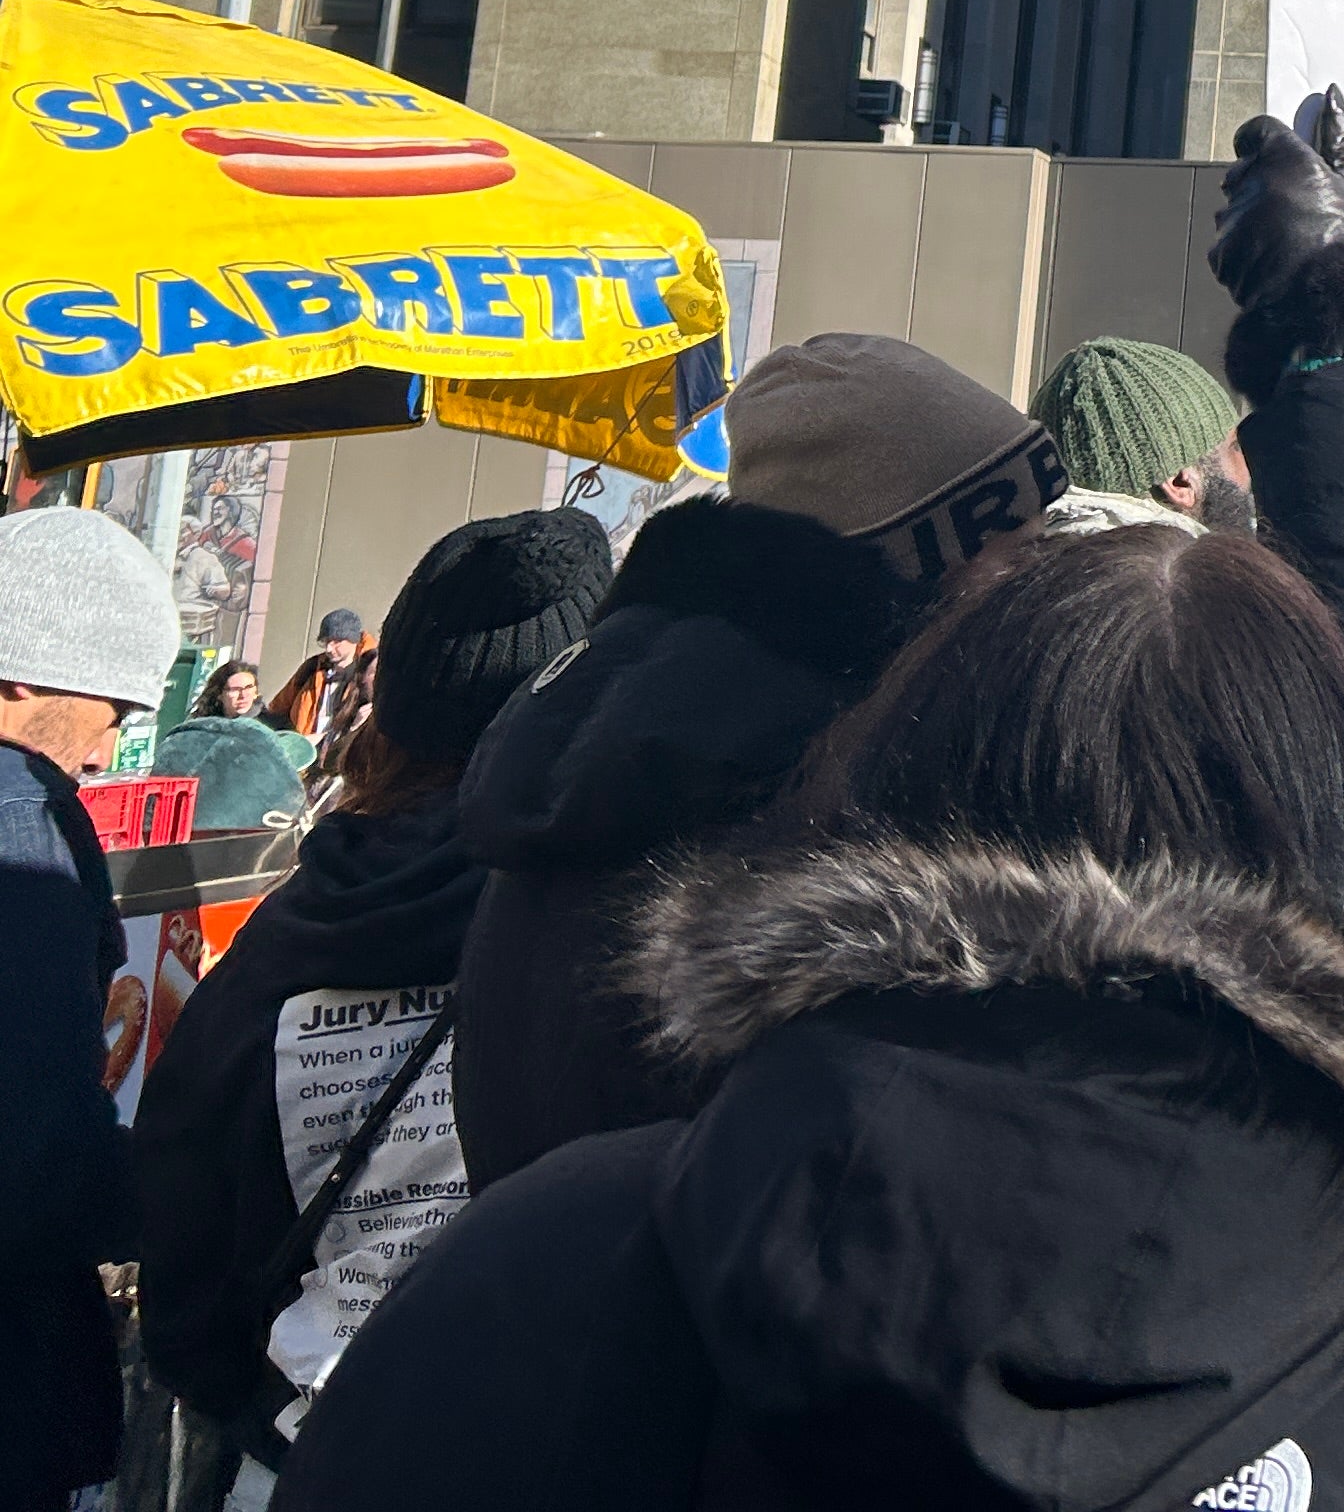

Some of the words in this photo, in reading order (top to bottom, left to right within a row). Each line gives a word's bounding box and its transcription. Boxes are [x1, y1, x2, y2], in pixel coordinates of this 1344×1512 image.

[13, 72, 427, 150] SABRETT
[3, 246, 681, 376] SABRETT
[621, 329, 681, 357] 2019
[299, 999, 390, 1032] Jury
[299, 1046, 363, 1069] When
[369, 1045, 383, 1059] a
[299, 1072, 393, 1100] chooses
[302, 1108, 354, 1129] even
[392, 1123, 430, 1142] they
